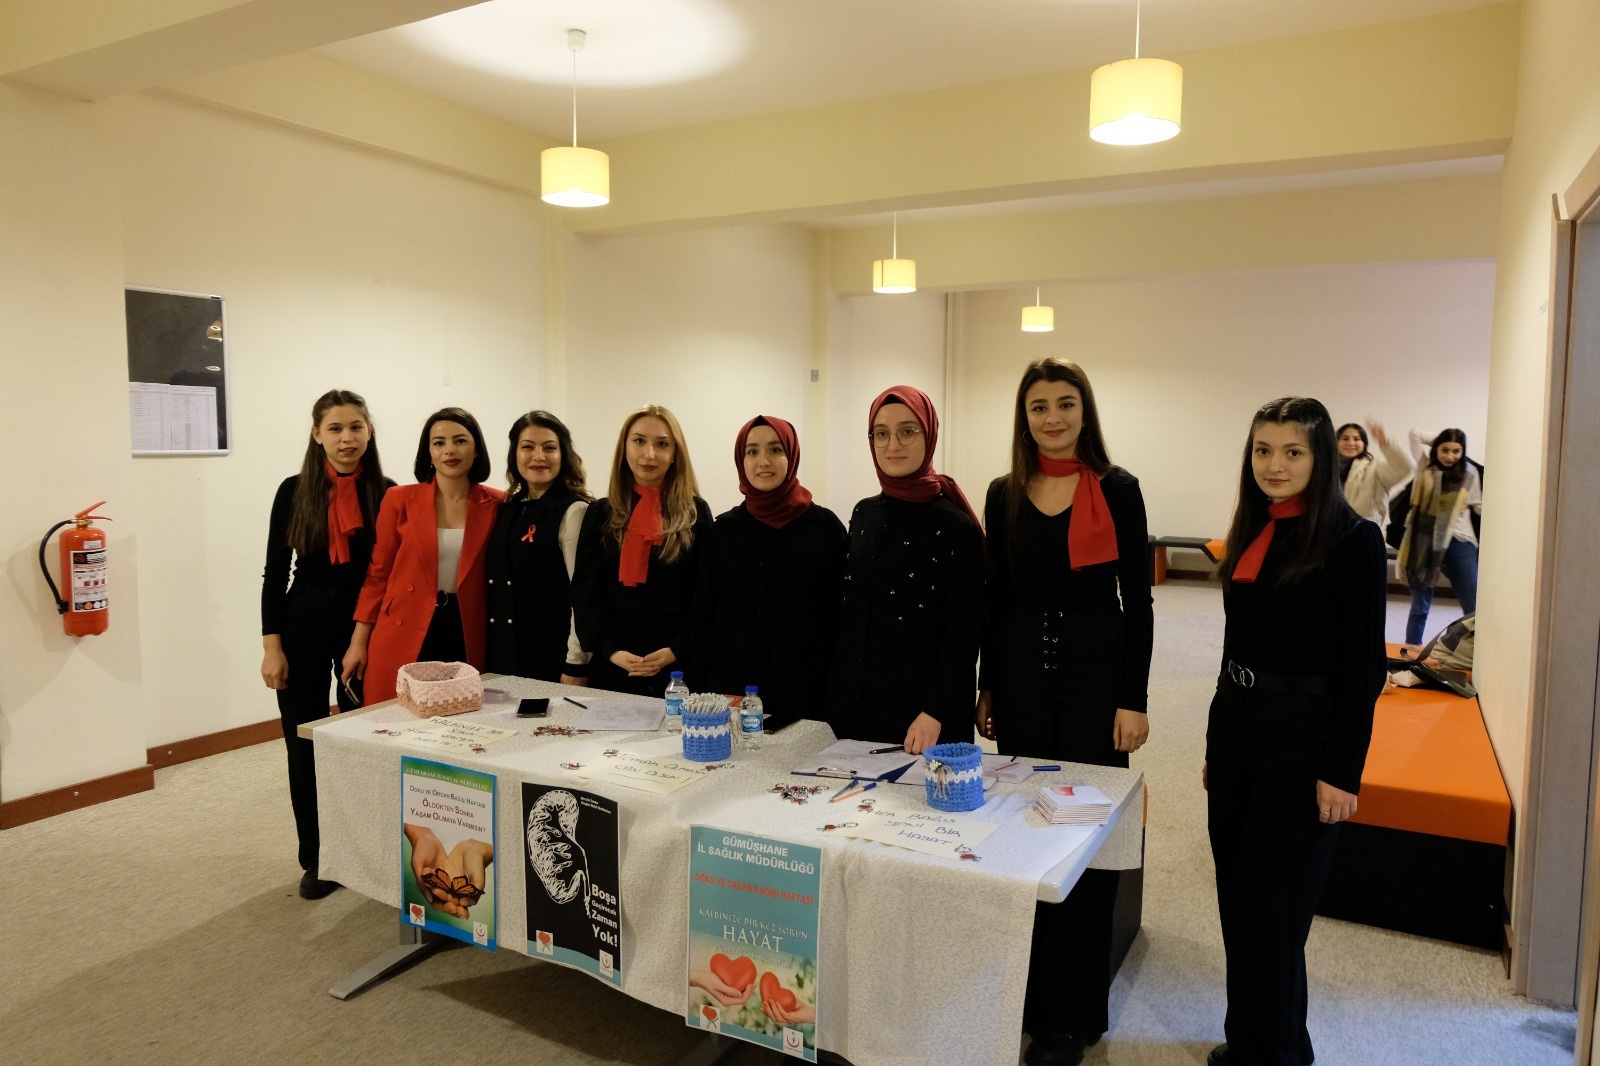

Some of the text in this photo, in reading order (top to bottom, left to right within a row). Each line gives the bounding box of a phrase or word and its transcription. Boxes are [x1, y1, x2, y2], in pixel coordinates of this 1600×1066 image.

[722, 835, 789, 857] GÜMÜŞHANE
[697, 841, 815, 875] İL SAĞLIK MÜDÜRLÜĞÜ
[592, 883, 617, 905] Boşa
[695, 872, 715, 885] DOKU
[717, 877, 726, 887] VE
[727, 879, 753, 892] ORGAN
[781, 891, 815, 905] HAFTASI
[592, 909, 618, 929] Zaman
[592, 923, 618, 948] Yok!
[723, 924, 784, 953] HAYAT
[778, 925, 808, 939] SORUN
